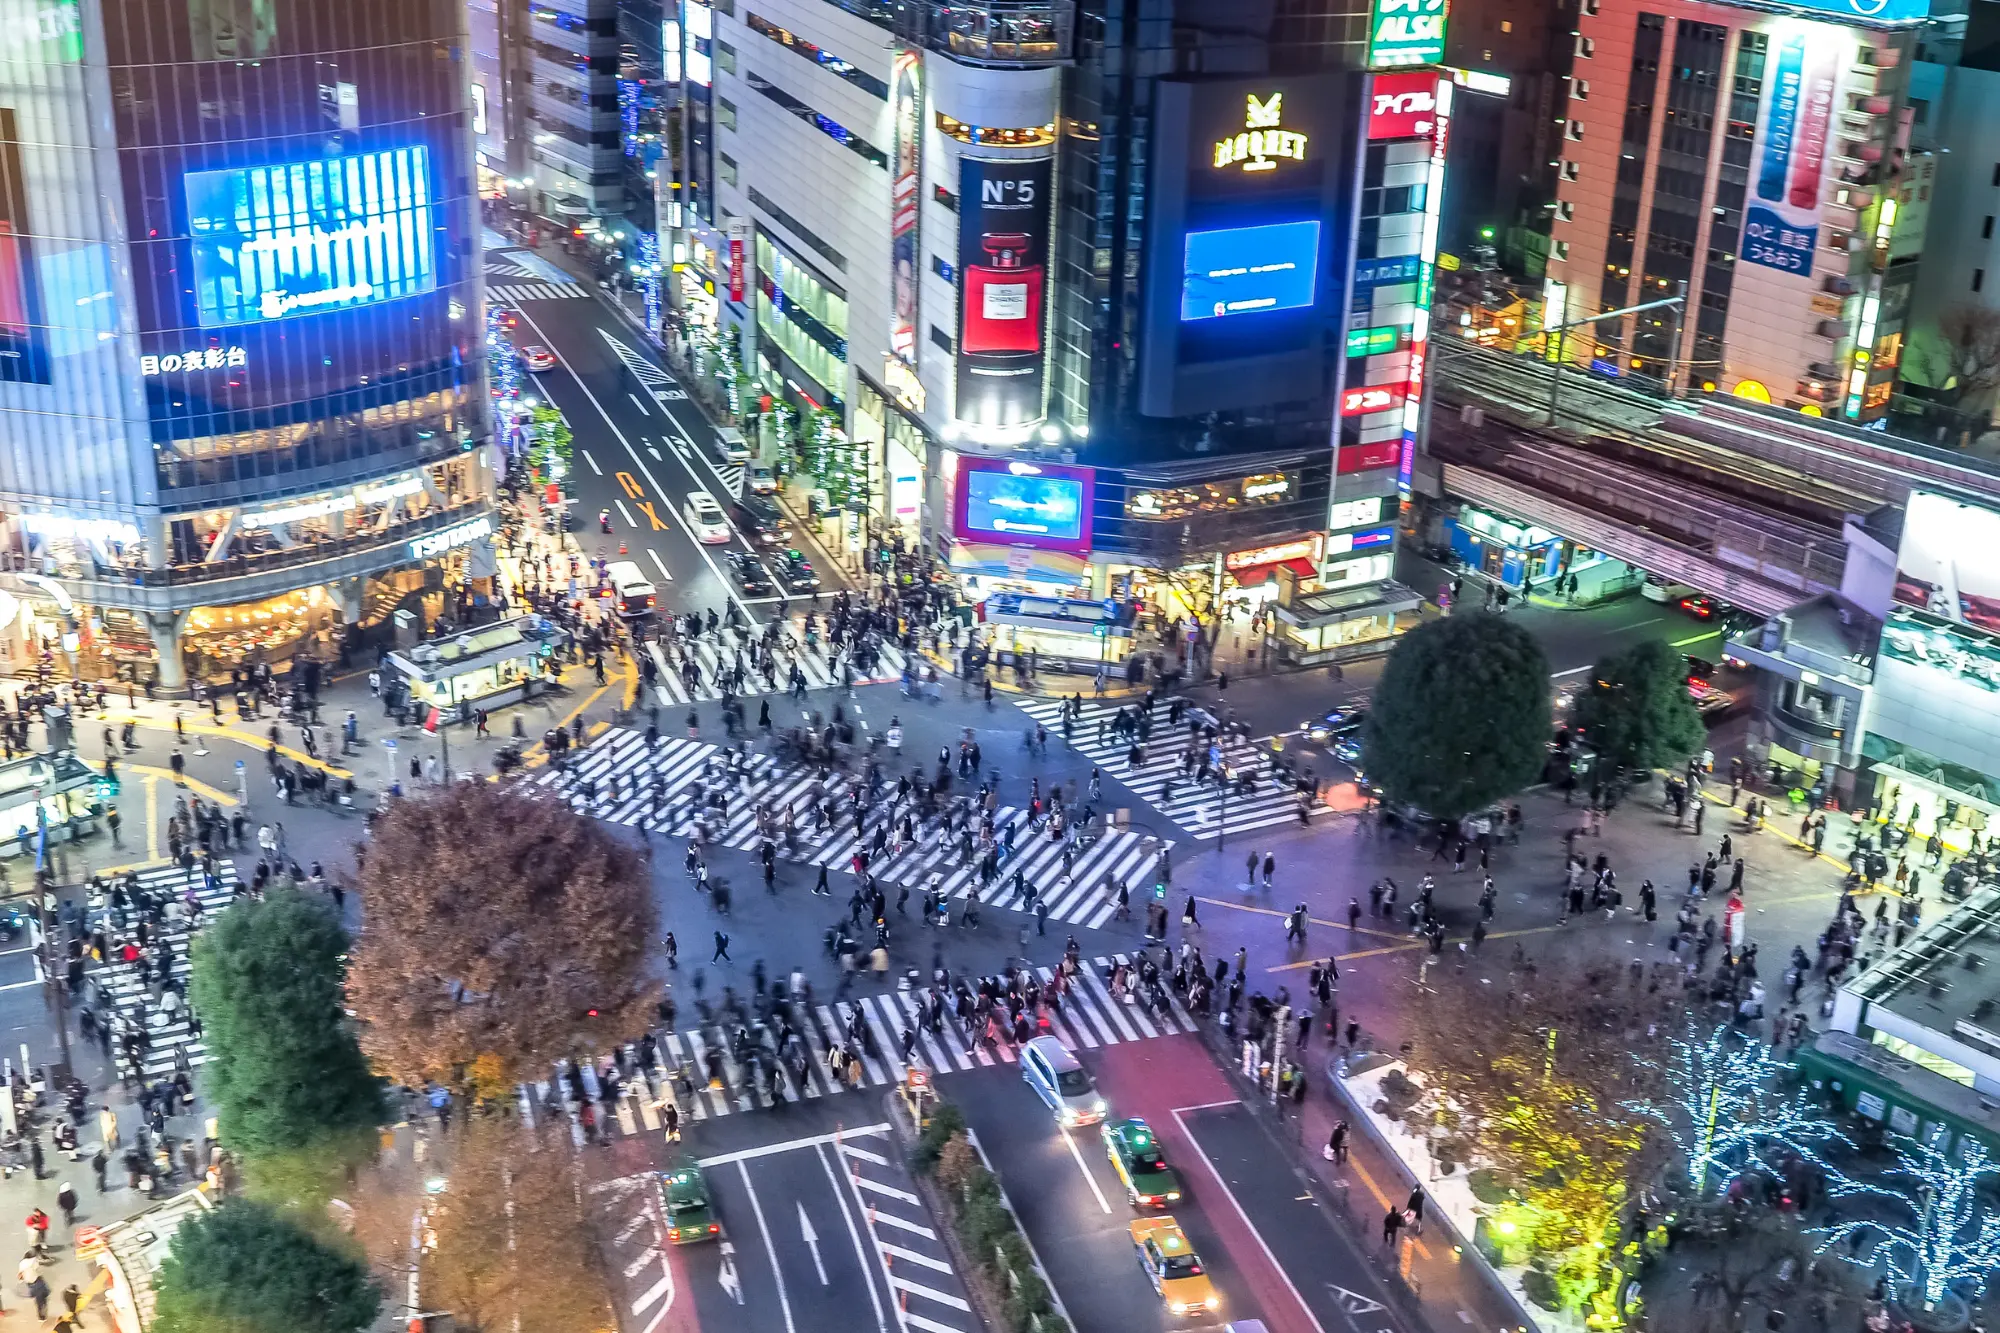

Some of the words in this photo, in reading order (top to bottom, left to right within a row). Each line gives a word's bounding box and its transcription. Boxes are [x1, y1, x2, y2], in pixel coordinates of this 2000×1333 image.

[1375, 14, 1443, 42] ALSA
[140, 346, 246, 376] 目の表彰台
